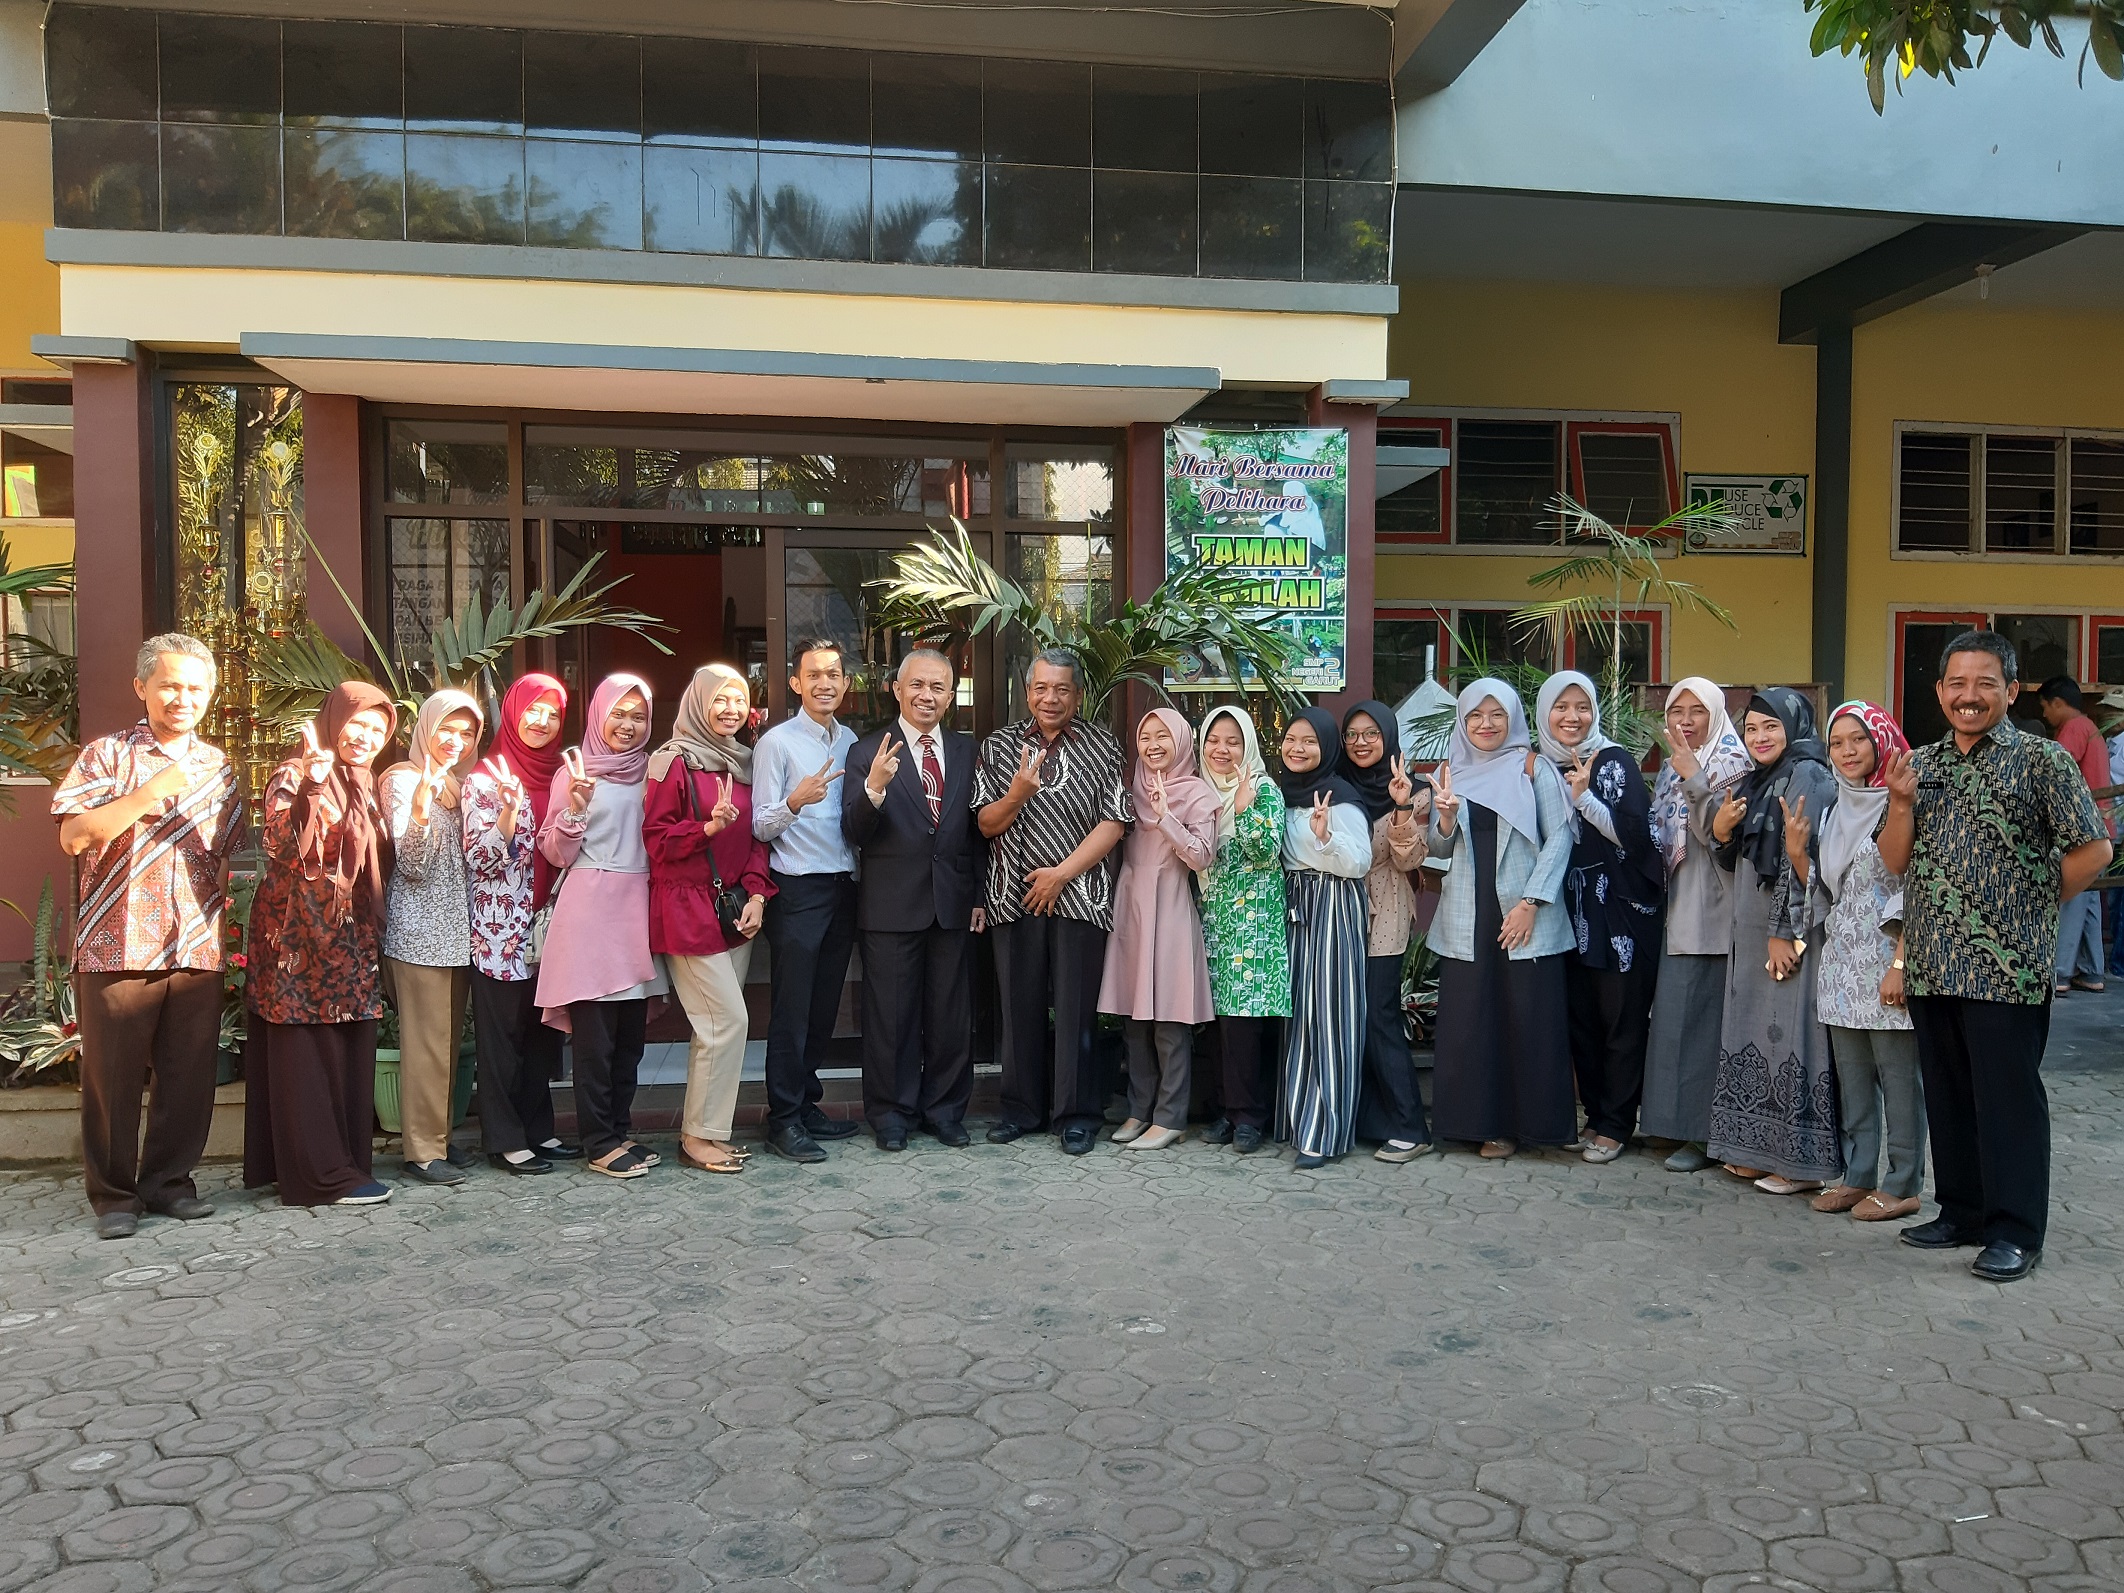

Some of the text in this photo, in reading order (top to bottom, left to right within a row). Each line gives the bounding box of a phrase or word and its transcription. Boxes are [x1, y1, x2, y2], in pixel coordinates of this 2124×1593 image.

[1168, 454, 1336, 479] Mari Bersama
[1201, 487, 1306, 514] Pelihara
[1196, 537, 1306, 567] TAMAN
[1291, 667, 1324, 676] NEGERI
[1303, 657, 1341, 677] SMP 2
[1304, 676, 1341, 686] GARUT
